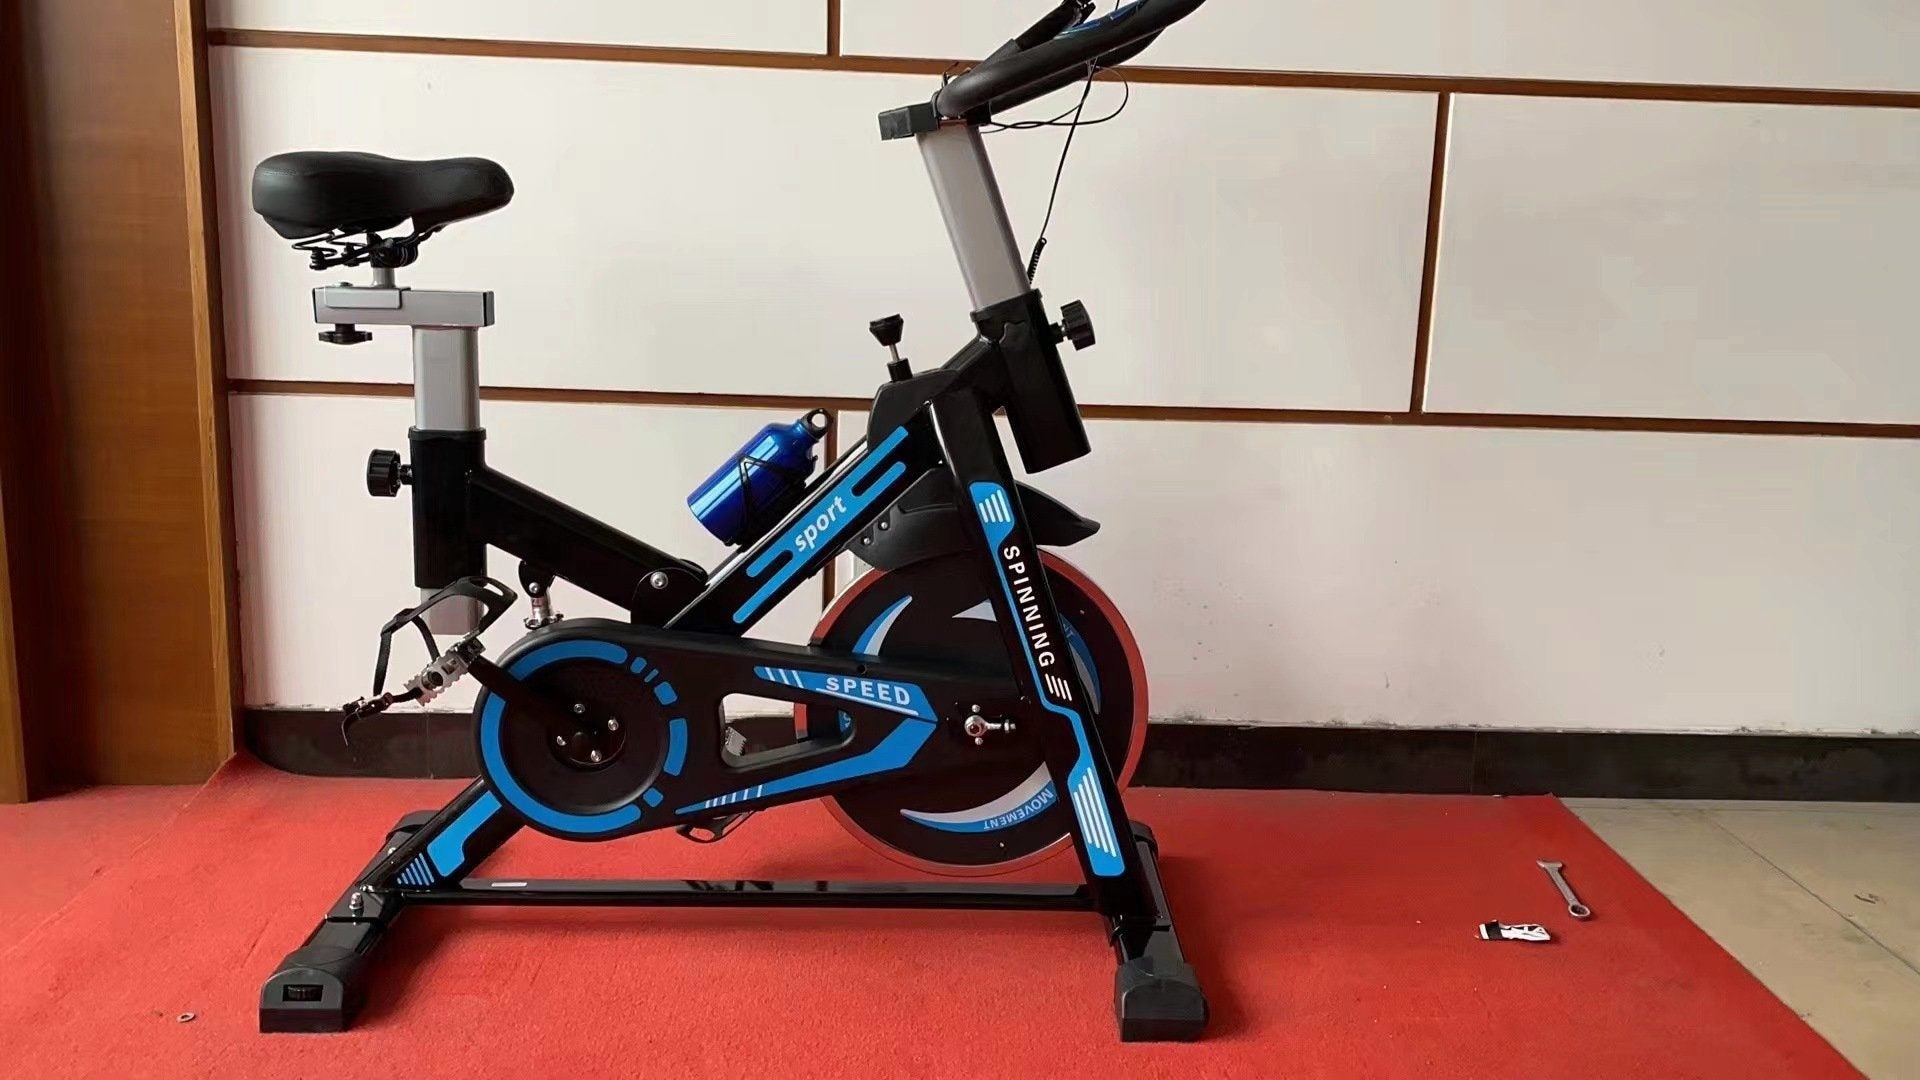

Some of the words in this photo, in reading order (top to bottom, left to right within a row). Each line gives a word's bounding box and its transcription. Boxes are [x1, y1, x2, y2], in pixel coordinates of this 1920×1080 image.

[795, 496, 847, 552] sport
[1003, 545, 1056, 668] SPINNING
[826, 677, 911, 705] SPEED
[983, 788, 1054, 830] MOVEMENT
